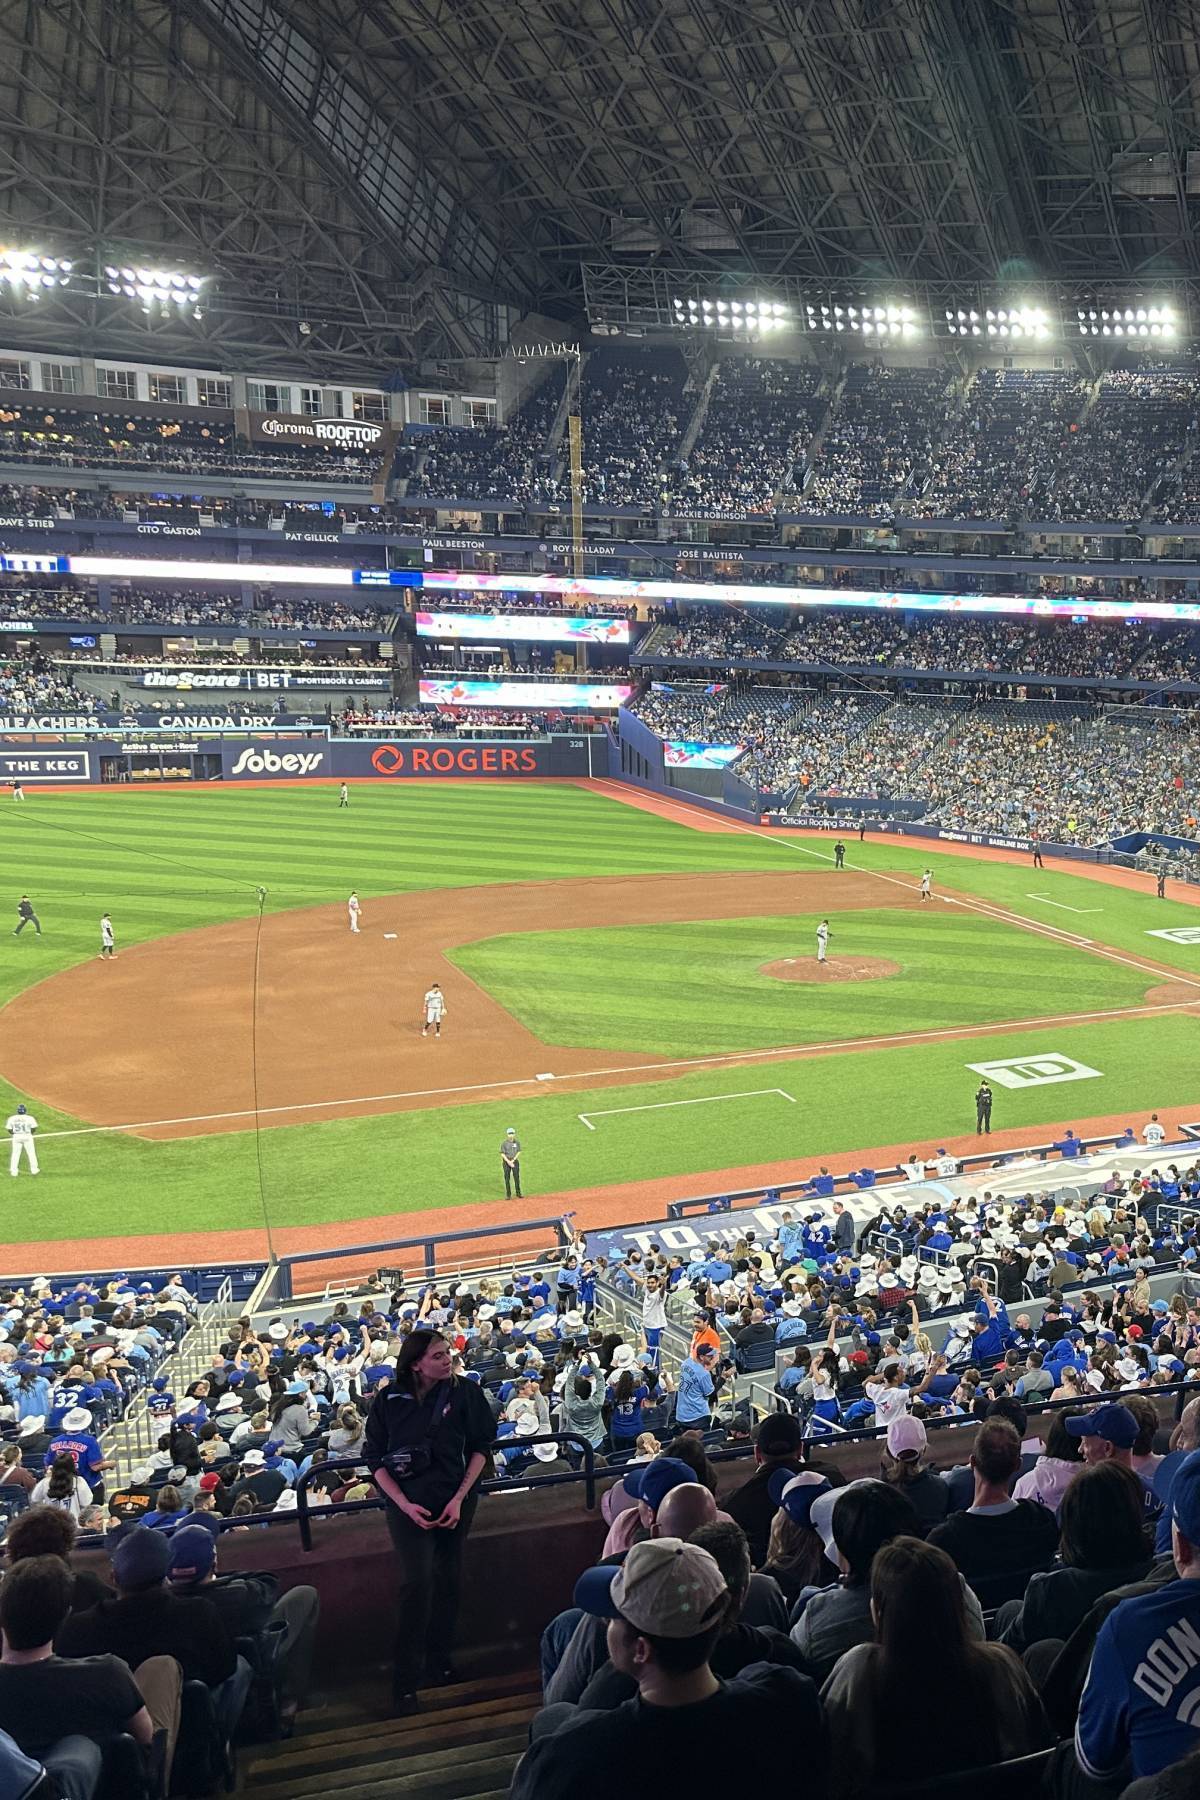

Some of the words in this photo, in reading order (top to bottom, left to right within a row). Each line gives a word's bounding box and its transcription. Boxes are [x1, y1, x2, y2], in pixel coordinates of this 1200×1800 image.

[261, 420, 315, 436] Corona
[316, 424, 381, 443] ROOFTOP
[335, 440, 364, 448] PATIO
[674, 510, 702, 518] JACKIE
[704, 511, 747, 520] ROBINSON
[0, 518, 23, 527] DAVE
[28, 519, 55, 528] STIEB
[137, 525, 159, 534] CITO
[163, 526, 201, 536] GASTON
[285, 532, 301, 541] PAT
[303, 533, 339, 543] GILLICK
[422, 539, 444, 548] PAUL
[446, 540, 485, 549] BEESTON
[552, 545, 570, 553] ROY
[573, 546, 615, 555] HALLADAY
[703, 551, 744, 561] BAUTISTA
[144, 671, 241, 691] theScore
[257, 673, 292, 688] BET
[297, 677, 347, 685] SPORTSBOOK
[354, 678, 383, 686] CASINO
[158, 716, 236, 728] CANADA
[569, 740, 584, 748] 328
[5, 761, 40, 771] THE
[46, 760, 79, 771] KEG
[231, 748, 324, 775] Sobeys
[412, 748, 537, 772] ROGERS
[781, 816, 807, 825] Official
[839, 819, 860, 831] Shing
[984, 1060, 1077, 1080] TD
[807, 1231, 824, 1243] 42
[54, 1392, 79, 1408] 32
[617, 1403, 634, 1416] 13
